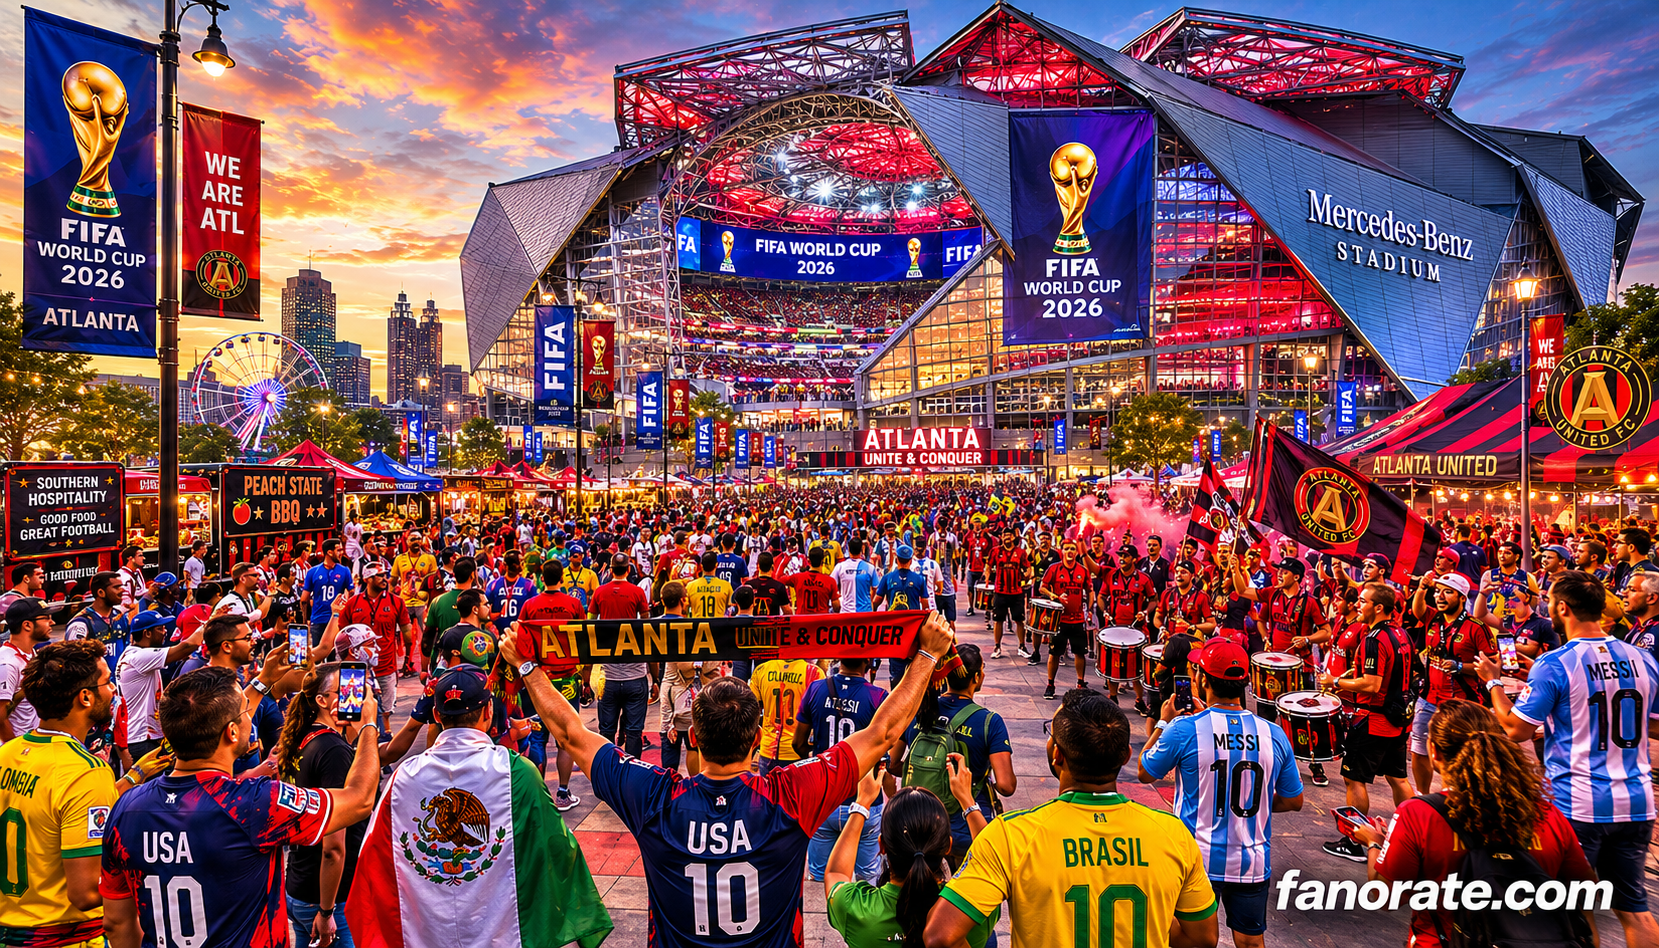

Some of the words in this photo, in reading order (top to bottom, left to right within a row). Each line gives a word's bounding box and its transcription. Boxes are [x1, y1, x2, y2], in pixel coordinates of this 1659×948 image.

[205, 151, 241, 180] WE
[202, 181, 243, 206] ARE
[61, 217, 126, 247] FIFA
[200, 208, 244, 235] ATL
[1308, 188, 1474, 260] Mercedes-Benz
[37, 240, 107, 264] WORLD
[112, 250, 146, 268] CUP
[756, 238, 786, 254] FIFA
[789, 240, 846, 256] WORLD
[849, 242, 882, 257] CUP
[1337, 241, 1441, 282] STADIUM
[61, 265, 125, 290] 2026
[797, 260, 836, 275] 2026
[1046, 258, 1100, 278] FIFA
[1024, 280, 1084, 296] WORLD
[1088, 279, 1122, 294] CUP
[43, 307, 140, 332] ATLANTA
[1042, 298, 1103, 318] 2026
[544, 321, 566, 390] FIFA
[1538, 338, 1555, 354] WE
[1560, 350, 1632, 376] ATLANTA
[643, 382, 658, 428] FIFA
[1341, 390, 1353, 422] FIFA
[700, 424, 710, 453] FIFA
[864, 428, 980, 450] ATLANTA
[1556, 419, 1610, 446] UNITED
[1616, 418, 1635, 438] FC
[864, 452, 902, 465] UNITE
[906, 452, 916, 465] &
[920, 452, 982, 465] CONQUER
[1373, 456, 1432, 475] ATLANTA
[1437, 455, 1498, 477] UNITED
[36, 476, 99, 490] SOUTHERN
[244, 476, 286, 496] PEACH
[289, 476, 323, 496] STATE
[1309, 470, 1360, 498] ATLANTA
[28, 490, 108, 506] HOSPITALITY
[270, 499, 300, 524] BBQ
[20, 526, 59, 541] GREAT
[61, 523, 115, 537] FOOTBALL
[40, 513, 68, 525] GOOD
[71, 512, 97, 524] FOOD
[1302, 513, 1337, 542] UNITED
[1342, 530, 1356, 542] FC
[541, 622, 718, 660] ATLANTA
[735, 626, 791, 647] UNITE
[796, 626, 810, 645] &
[816, 625, 904, 647] CONQUER
[826, 714, 856, 752] 10
[1588, 688, 1644, 751] 10
[1213, 733, 1260, 752] MESSI
[0, 766, 40, 798] OMBIA
[1210, 759, 1264, 818] 10
[143, 832, 194, 864] USA
[687, 819, 752, 854] USA
[1062, 837, 1149, 868] BRASIL
[144, 875, 208, 948] 10
[684, 861, 760, 936] 10
[1065, 884, 1148, 948] 10
